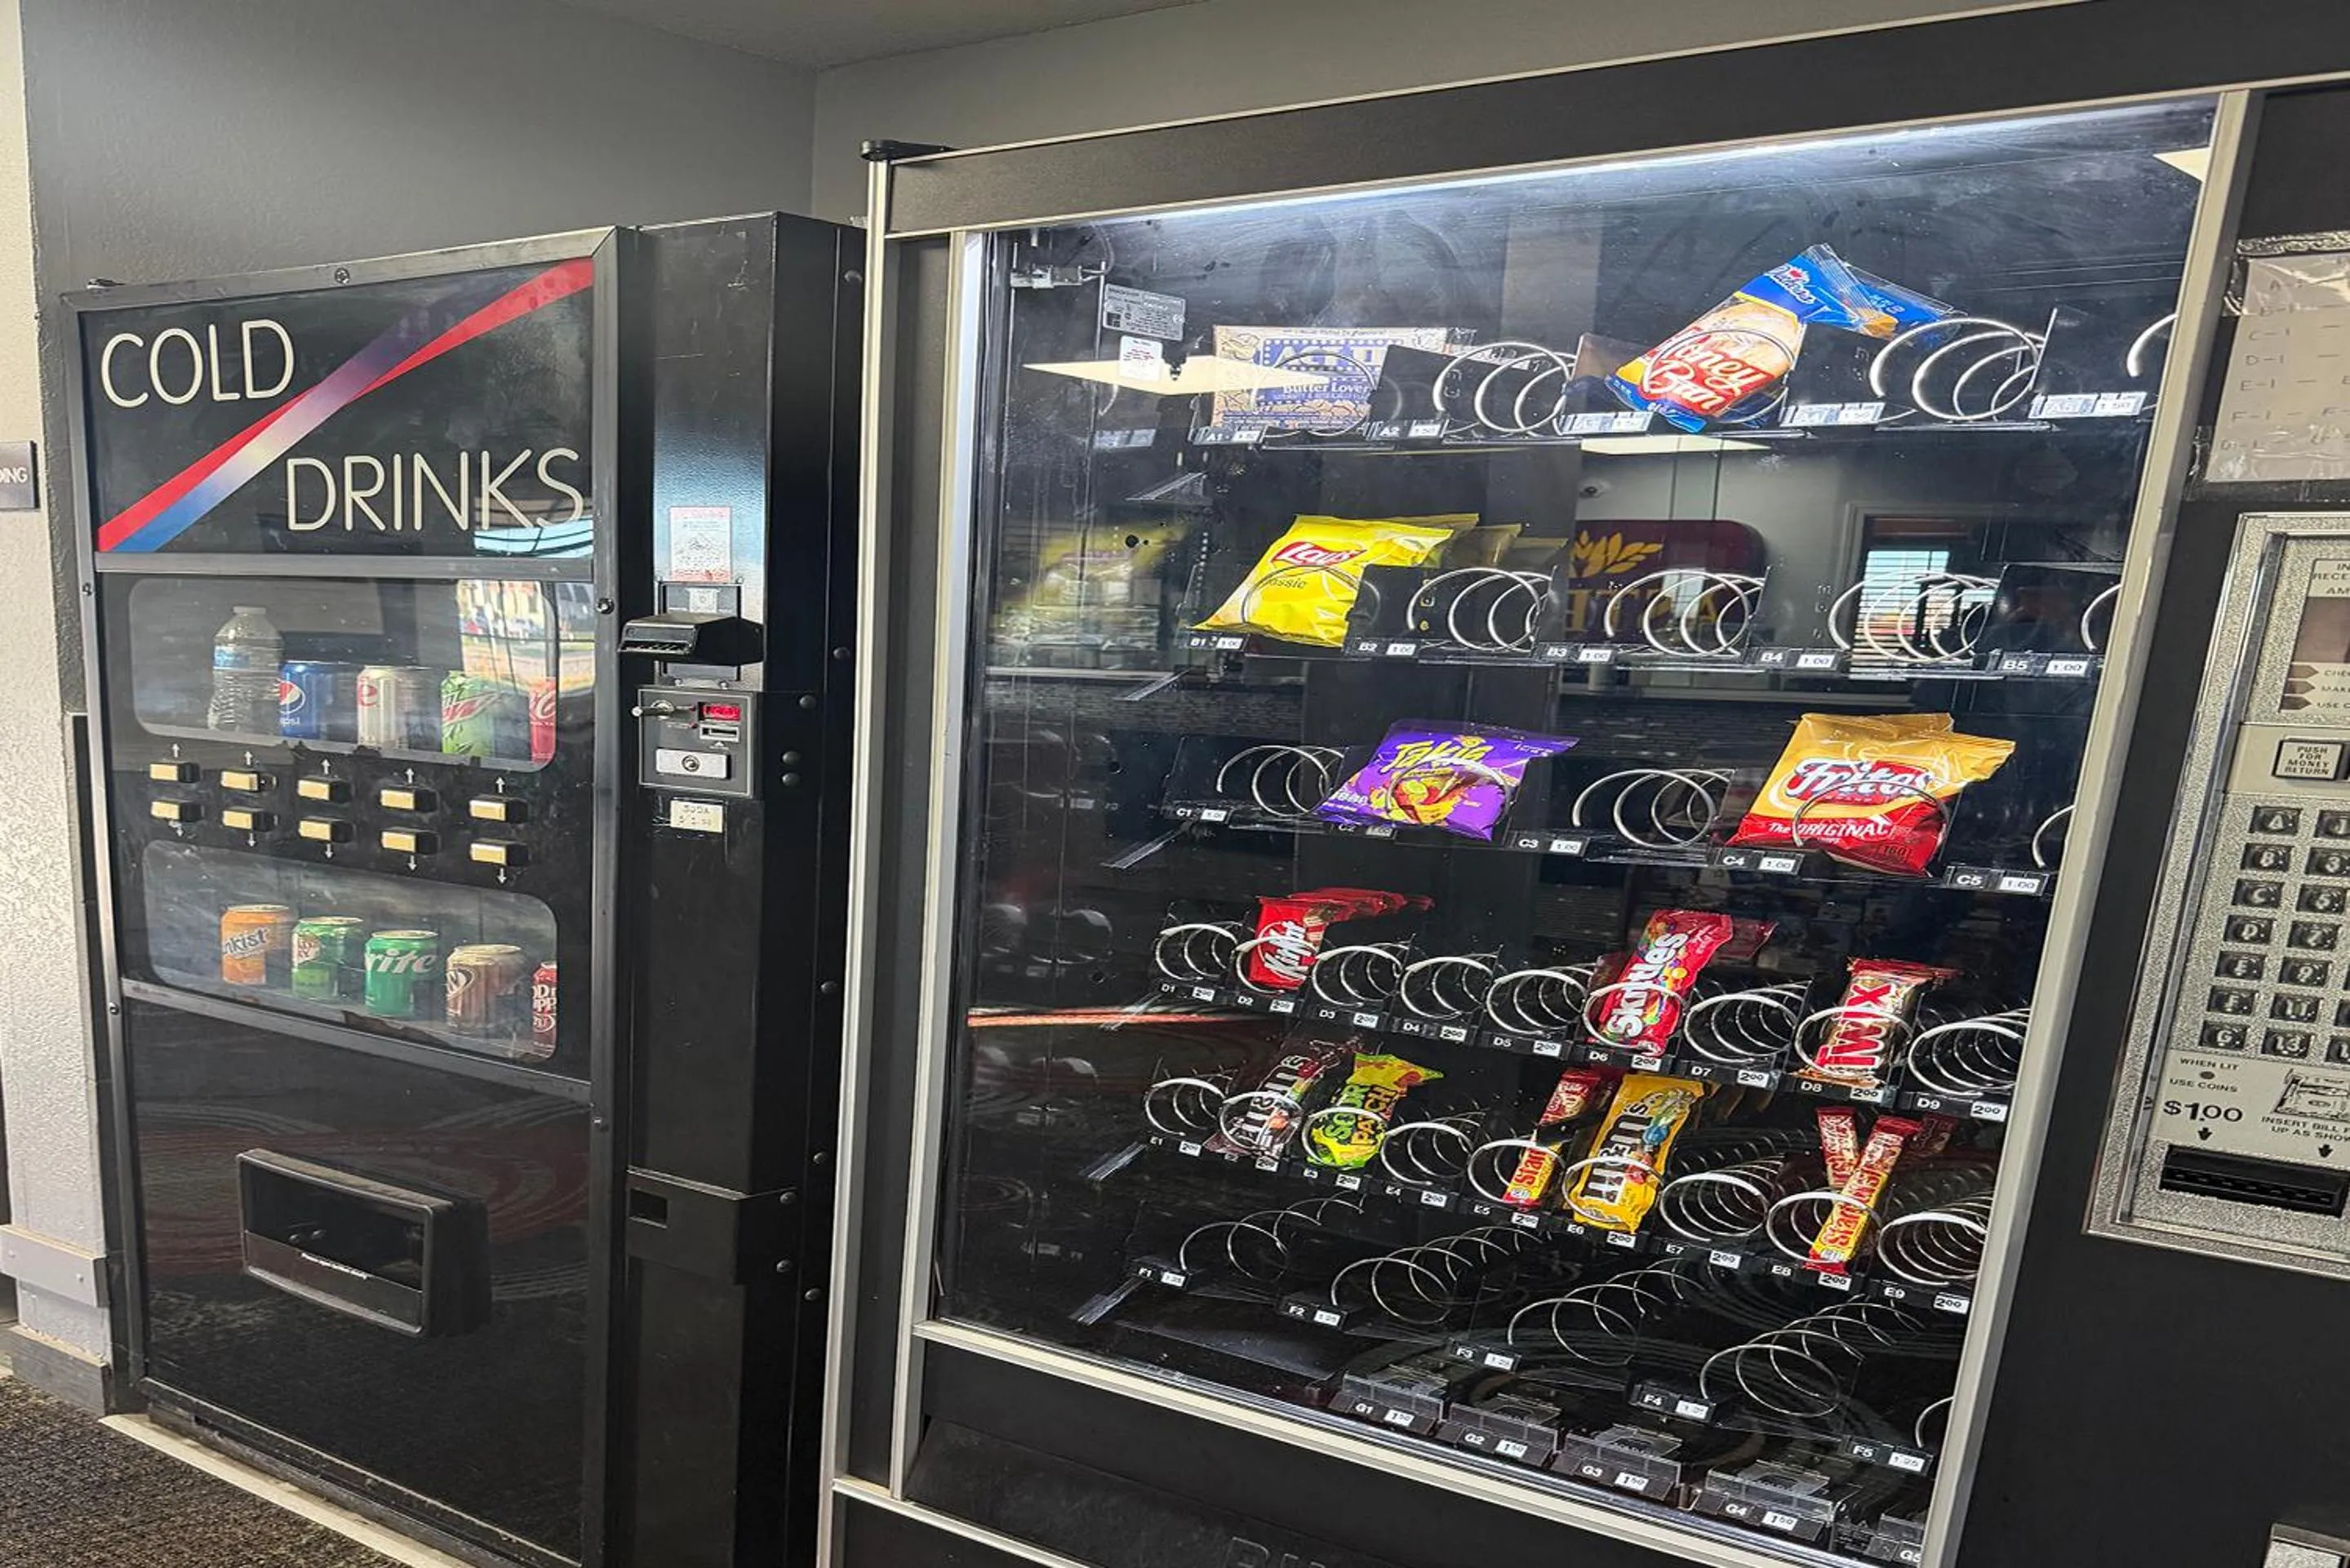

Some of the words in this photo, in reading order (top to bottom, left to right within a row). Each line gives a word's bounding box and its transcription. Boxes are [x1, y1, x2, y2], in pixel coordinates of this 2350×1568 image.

[1275, 346, 1343, 366] ACT
[100, 319, 295, 408] COLD
[1330, 382, 1375, 395] Lover
[1379, 427, 1401, 437] A2
[287, 448, 584, 531] DRINKS
[1358, 642, 1378, 651] B2
[1761, 652, 1784, 662] B4
[2002, 660, 2028, 670] B5
[2287, 759, 2330, 767] MONEY
[2285, 766, 2330, 775] RETURN
[1785, 758, 1936, 797] Fritos
[1176, 808, 1193, 817] C1
[1768, 821, 1792, 834] The
[2268, 815, 2283, 830] A
[1519, 839, 1539, 849] C3
[1722, 856, 1745, 867] C4
[2260, 851, 2275, 867] B
[2326, 856, 2341, 873] 3
[1956, 873, 1982, 886] C5
[2253, 888, 2268, 903] C
[2241, 923, 2258, 939] D
[364, 948, 438, 975] rite
[2234, 960, 2249, 974] E
[2297, 966, 2313, 982] 9
[1162, 984, 1175, 993] D1
[1237, 996, 1255, 1006] D2
[2228, 995, 2240, 1010] F
[2286, 999, 2308, 1016] 11
[1319, 1010, 1335, 1019] D3
[1403, 1023, 1420, 1033] D4
[1494, 1037, 1512, 1047] D5
[2217, 1030, 2232, 1044] G
[2277, 1036, 2300, 1052] 13
[1589, 1051, 1609, 1062] D6
[2180, 1058, 2215, 1068] WHEN
[2220, 1062, 2240, 1071] LIT
[1691, 1066, 1712, 1077] D7
[1801, 1082, 1823, 1092] D8
[2169, 1078, 2194, 1087] USE
[2197, 1082, 2238, 1092] COINS
[1917, 1098, 1941, 1109] D9
[1324, 1084, 1371, 1141] SOUR
[1350, 1085, 1398, 1146] PACH
[2163, 1100, 2244, 1122] $1.00
[2261, 1116, 2307, 1128] INSERT
[2312, 1122, 2339, 1133] BILL
[1139, 1268, 1153, 1278] F1
[1289, 1306, 1306, 1317] F2
[1456, 1348, 1473, 1359] F3
[1644, 1394, 1663, 1406] F4
[1355, 1403, 1374, 1415] G1
[1464, 1433, 1485, 1445] G2
[1853, 1446, 1873, 1458] F5
[1582, 1465, 1603, 1477] G3
[1725, 1504, 1747, 1516] G4
